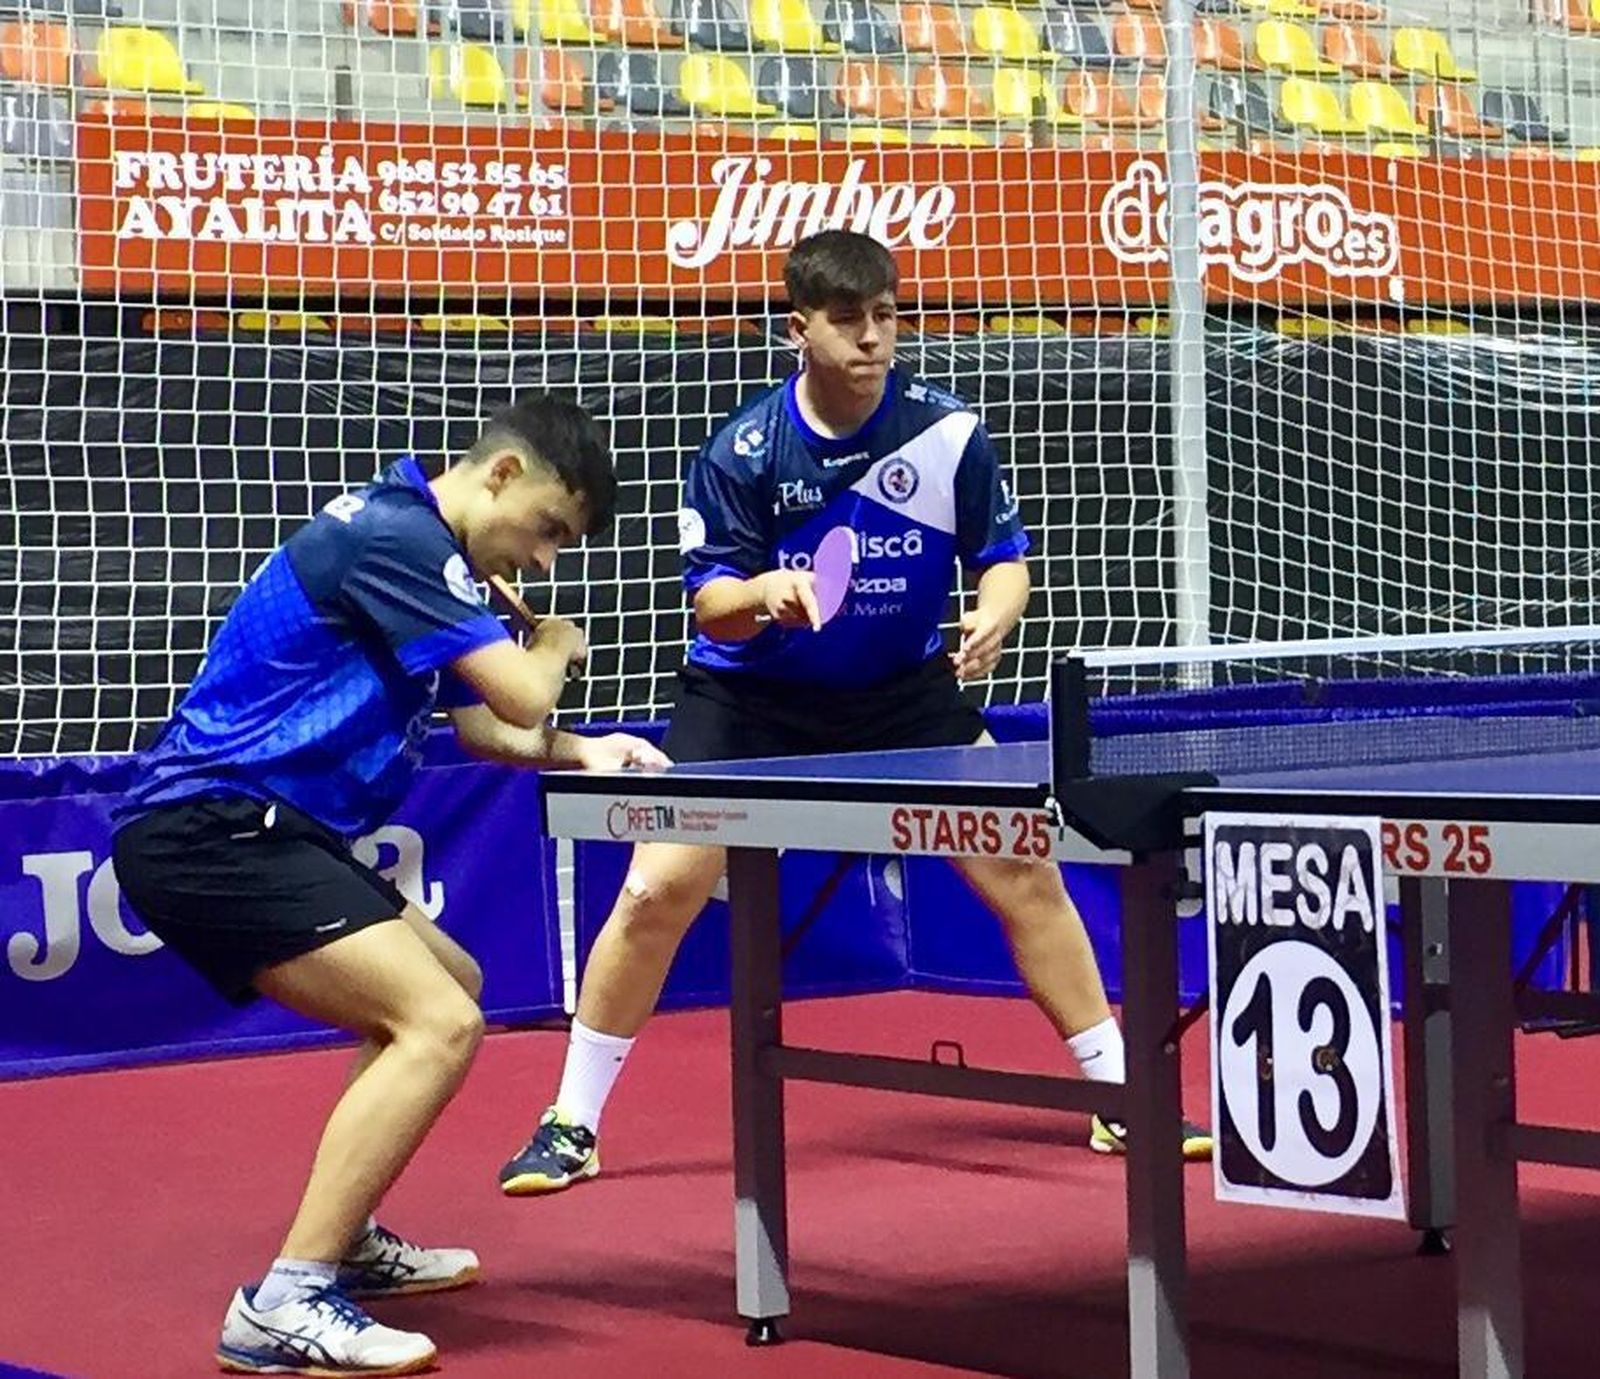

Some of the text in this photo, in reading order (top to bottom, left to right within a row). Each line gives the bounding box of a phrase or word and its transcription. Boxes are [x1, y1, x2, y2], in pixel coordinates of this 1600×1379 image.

[113, 148, 372, 194] FRUTERÍA
[377, 158, 566, 190] 968 52 85 65
[118, 196, 376, 244] AYALITA
[378, 188, 435, 215] 652
[487, 191, 522, 216] 47
[529, 190, 565, 216] 61
[668, 157, 956, 269] Jimbee
[1115, 176, 1386, 267] dagro.es
[891, 806, 1051, 858] STARS 25
[1442, 823, 1492, 874] 25
[1215, 841, 1374, 933] MESA
[1231, 971, 1359, 1159] 13
